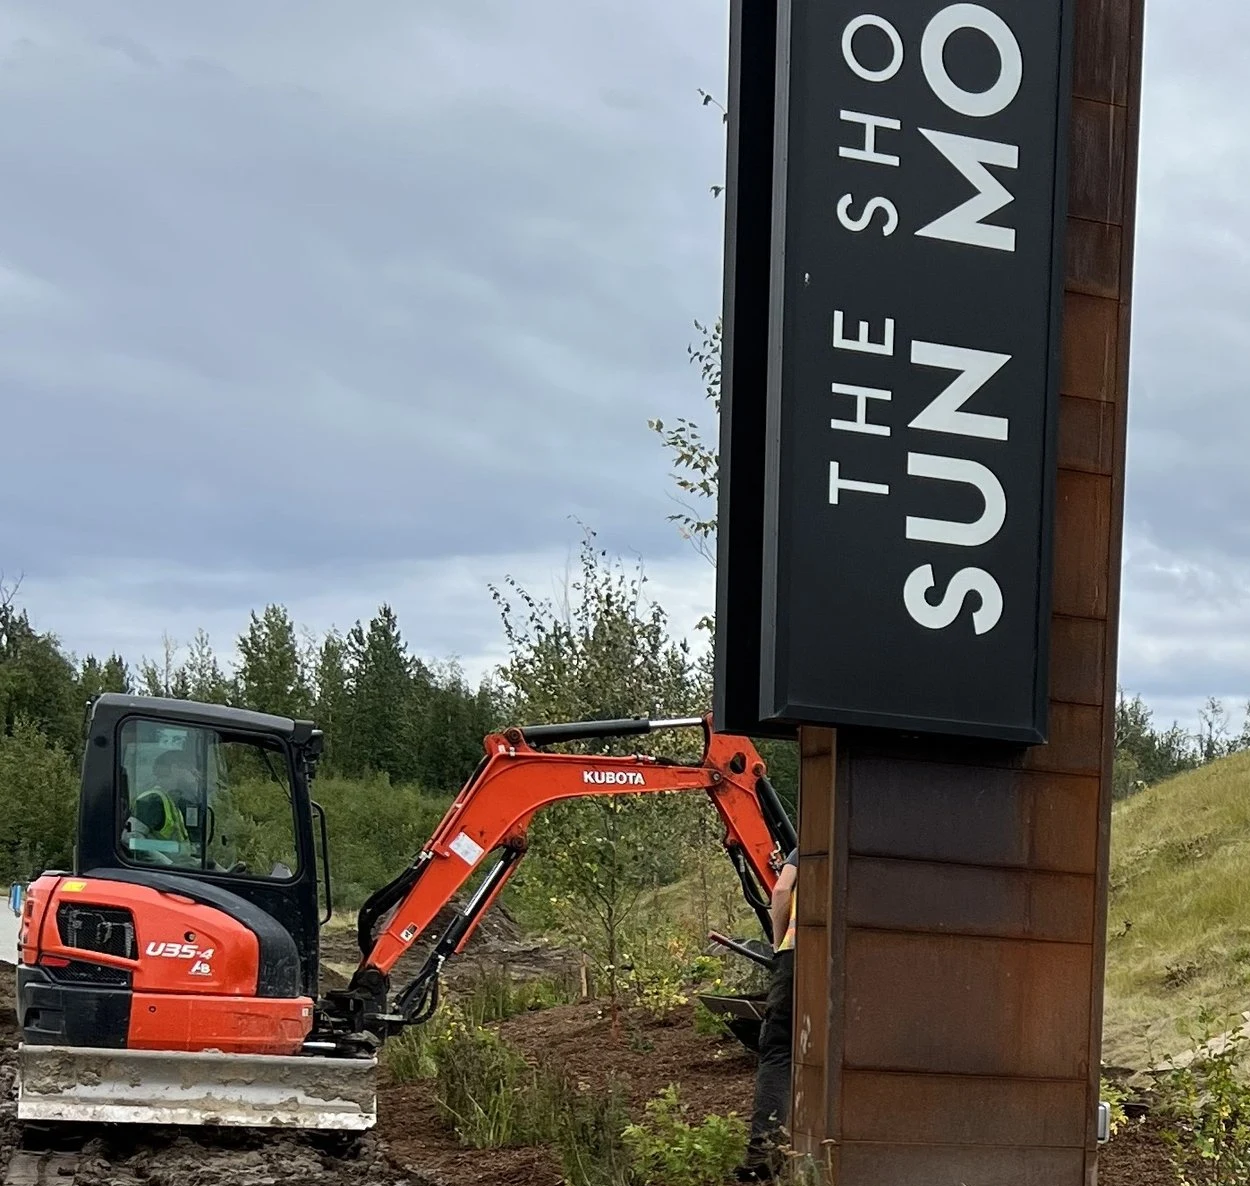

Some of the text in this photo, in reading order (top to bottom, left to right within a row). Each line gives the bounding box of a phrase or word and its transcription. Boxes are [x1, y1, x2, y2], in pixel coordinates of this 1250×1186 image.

[828, 14, 904, 505] THE SHO
[903, 3, 1023, 635] SUN MO
[583, 770, 646, 786] KUBOTA
[145, 941, 215, 960] U35-4
